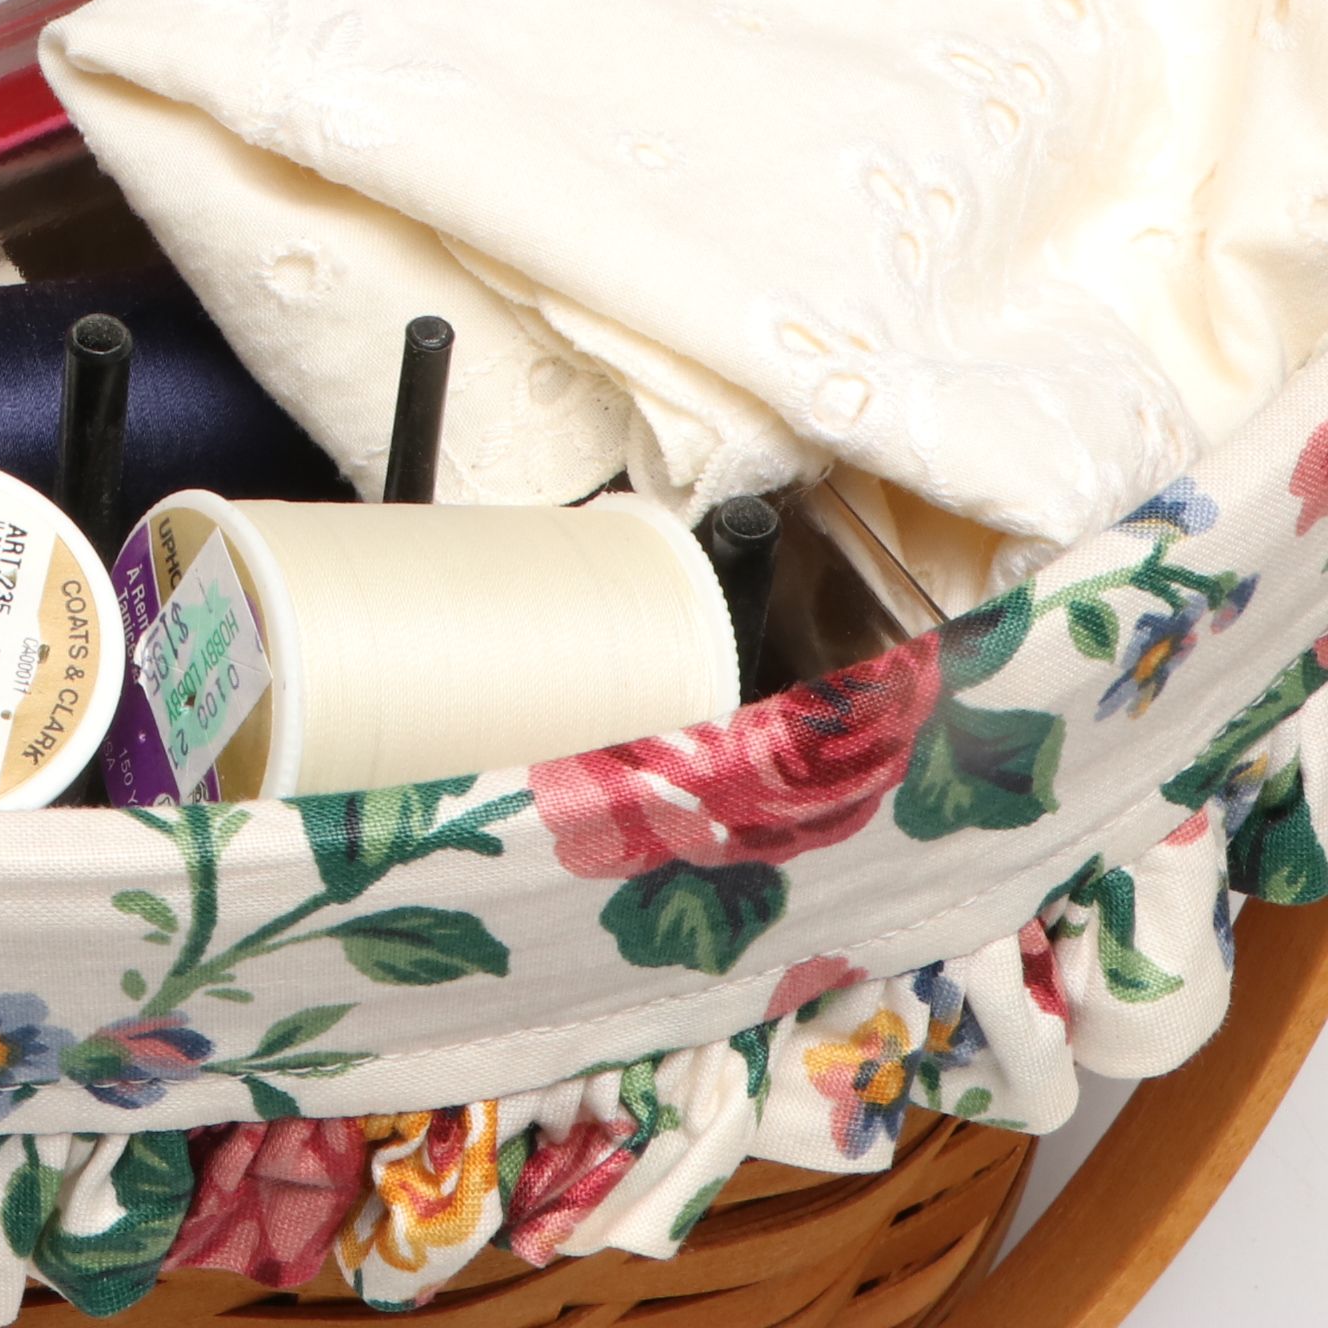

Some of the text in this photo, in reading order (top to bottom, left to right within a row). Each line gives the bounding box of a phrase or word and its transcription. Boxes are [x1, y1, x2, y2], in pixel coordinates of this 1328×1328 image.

[22, 579, 90, 766] COATS & CLARK
[165, 610, 240, 723] HOBBY LOBBY
[196, 663, 241, 731] 0100
[118, 747, 133, 786] 150
